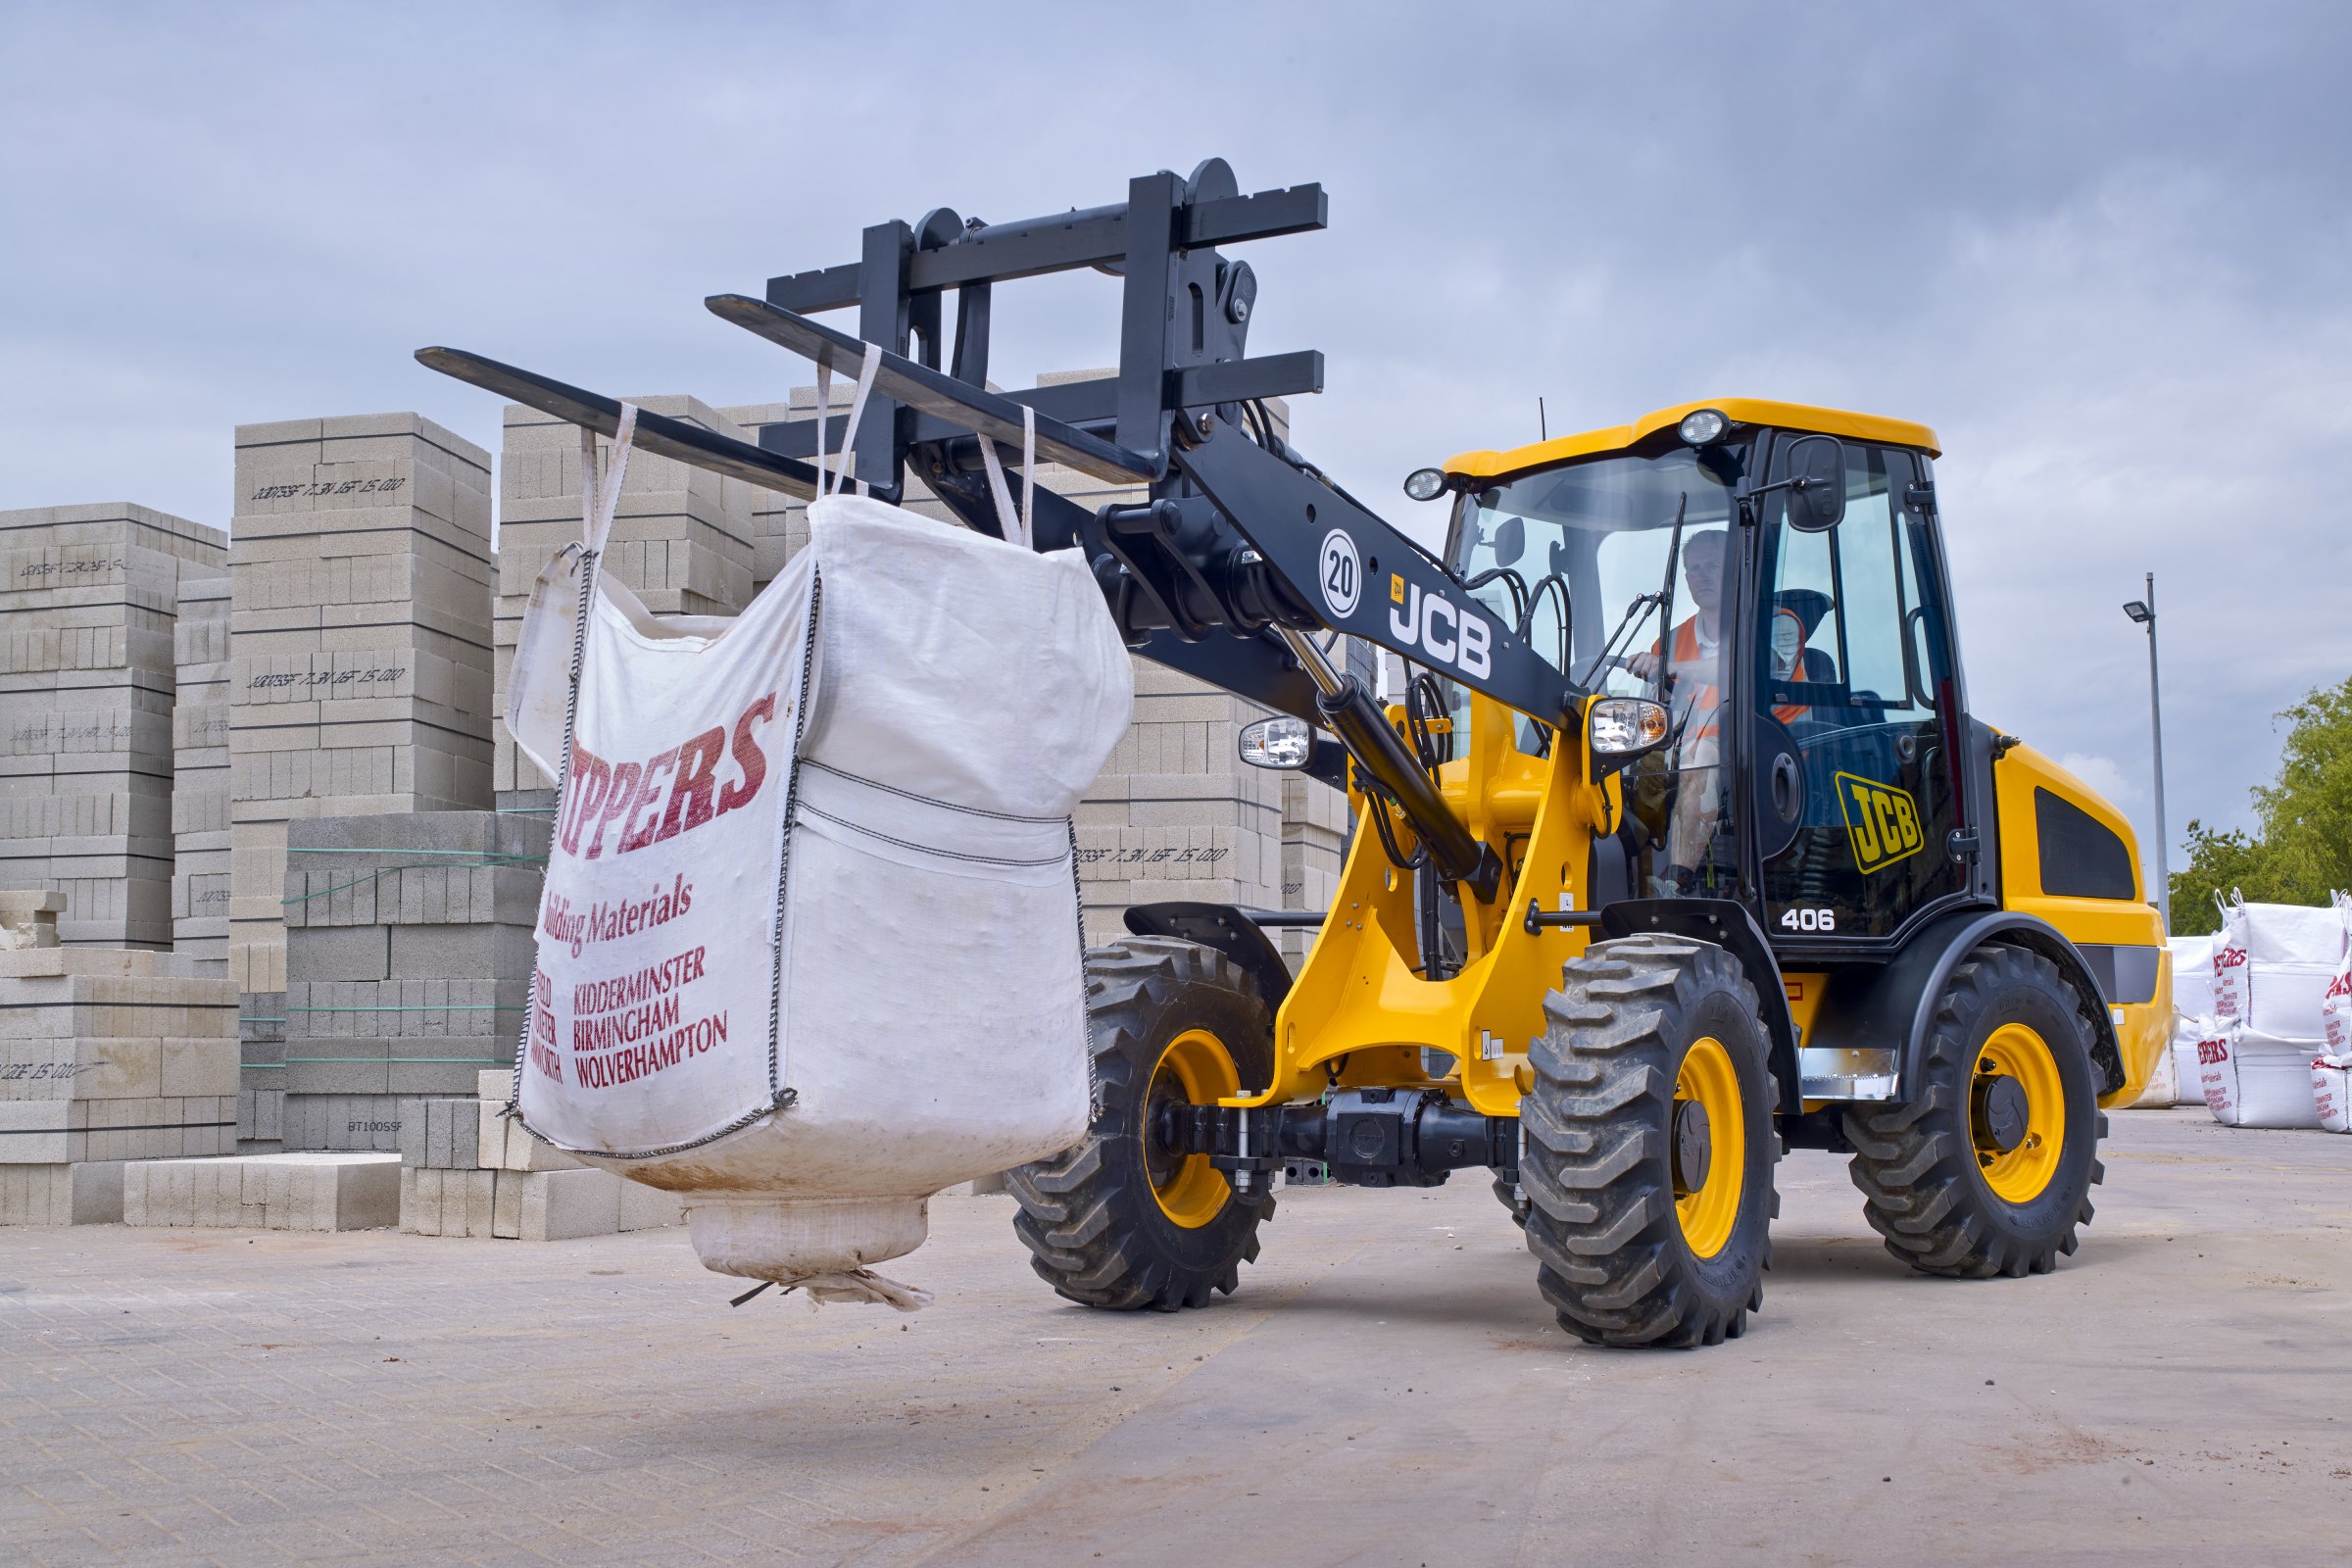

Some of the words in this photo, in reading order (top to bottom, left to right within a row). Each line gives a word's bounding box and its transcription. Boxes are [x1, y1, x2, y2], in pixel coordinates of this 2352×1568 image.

[1328, 550, 1353, 599] 20
[1390, 583, 1491, 680] JCB
[1851, 784, 1918, 863] JCB
[586, 872, 693, 943] Materials
[1781, 908, 1836, 931] 406
[573, 945, 706, 1016] KIDDERMINSTER
[573, 992, 680, 1052] BIRMINGHAM
[574, 1010, 728, 1090] WOLVERHAMPTON
